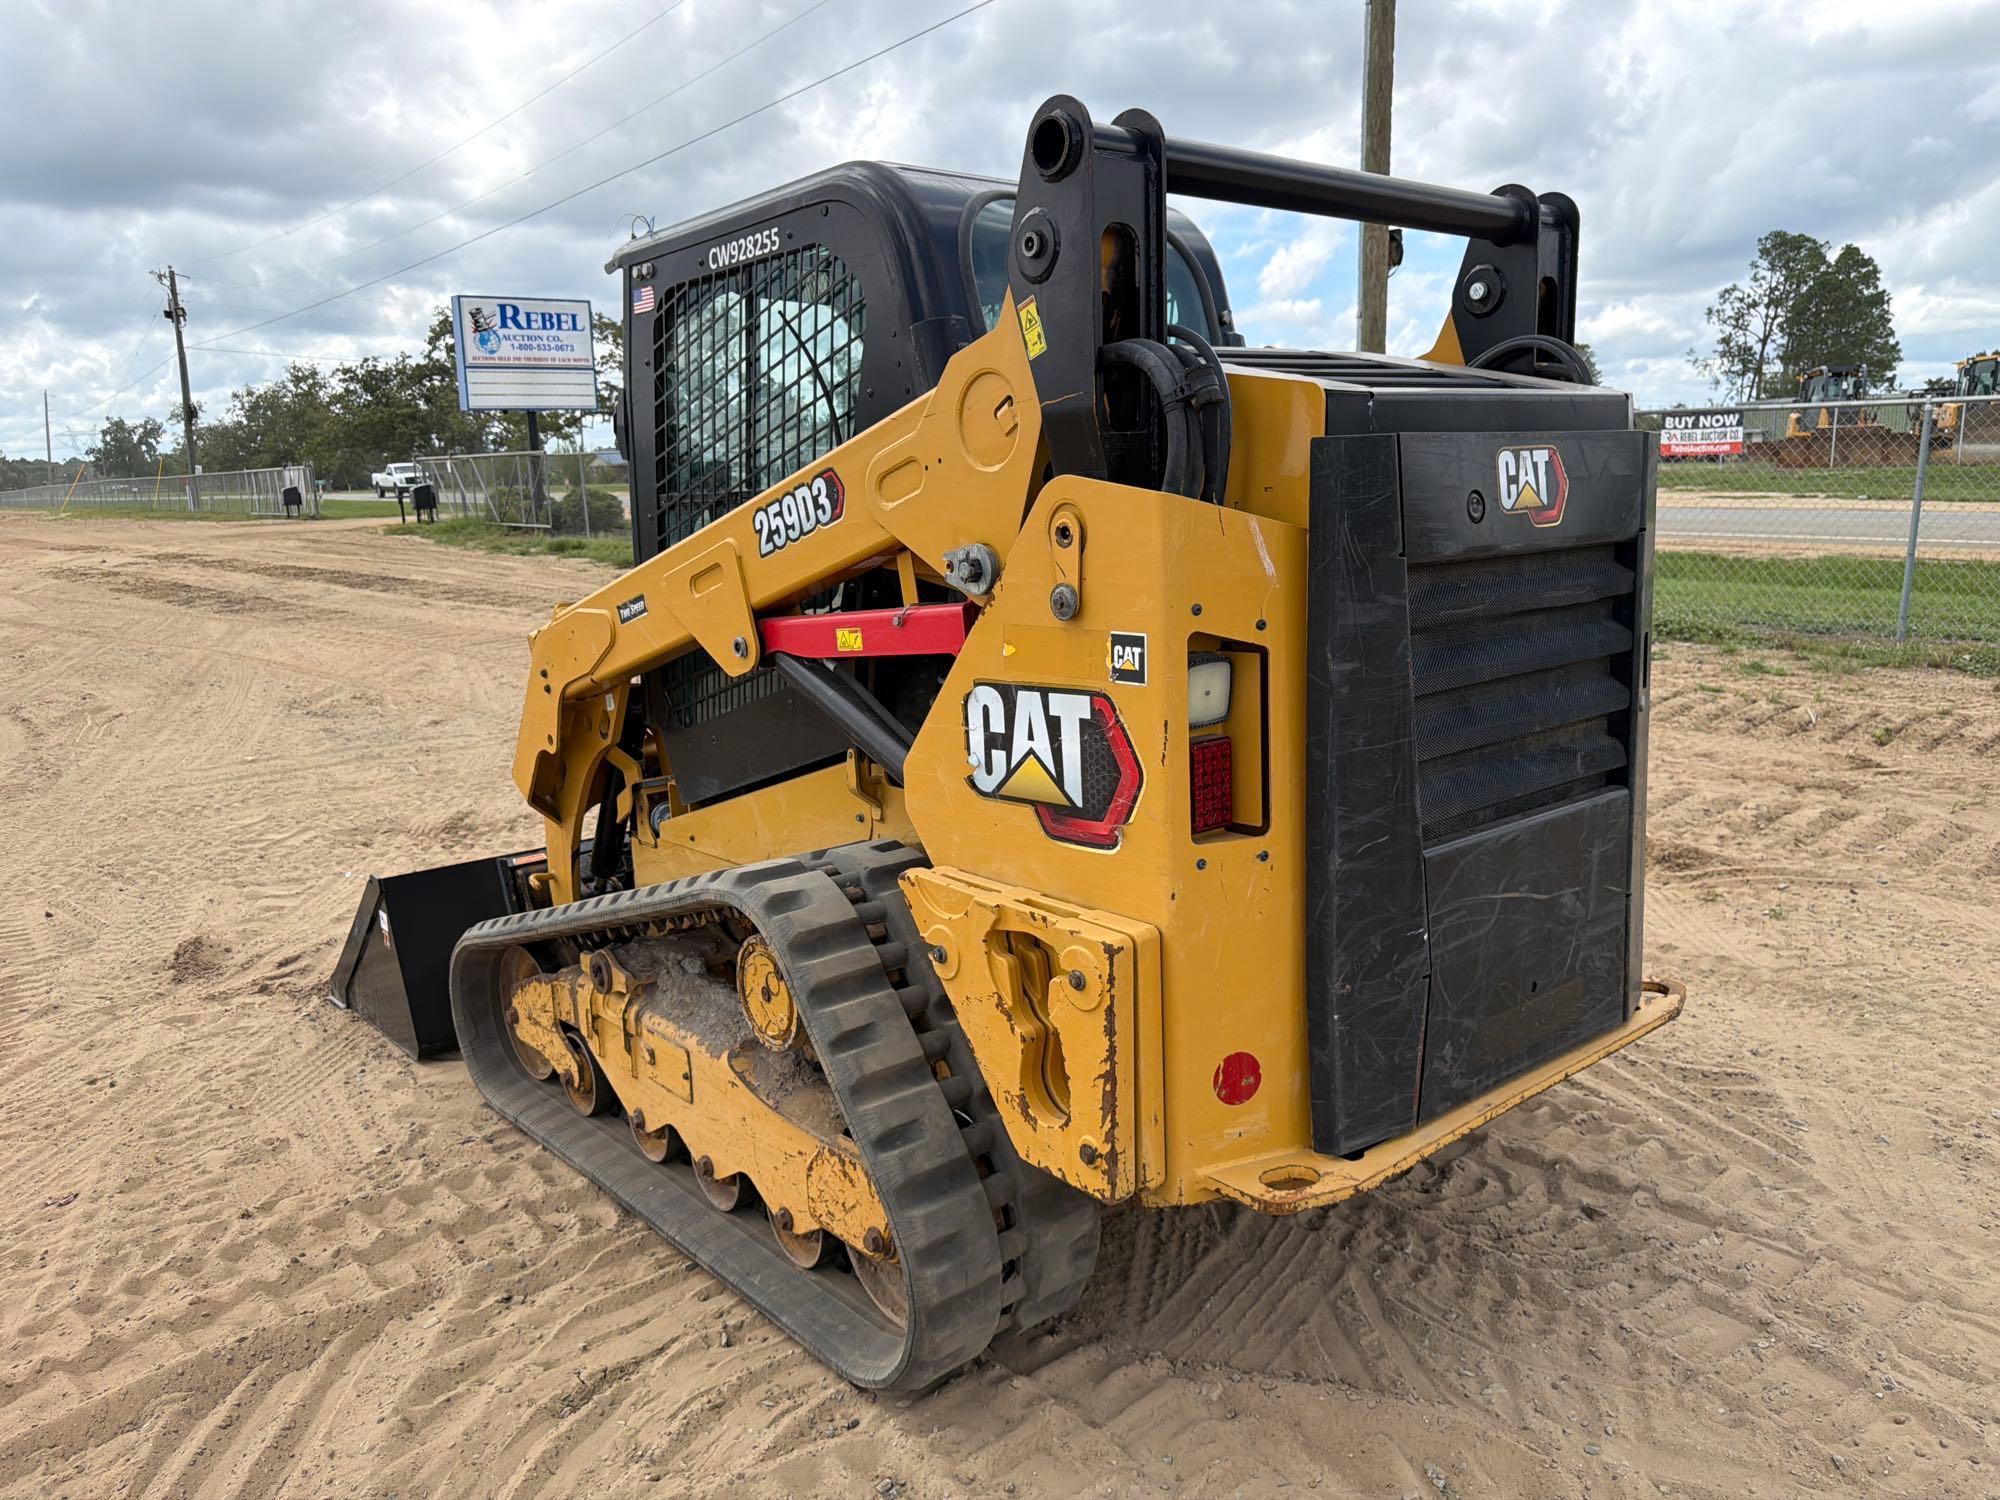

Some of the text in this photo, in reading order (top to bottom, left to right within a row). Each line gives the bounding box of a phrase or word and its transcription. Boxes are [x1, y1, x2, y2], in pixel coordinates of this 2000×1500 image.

[708, 226, 780, 269] CW928255
[497, 304, 586, 332] REBEL
[501, 334, 563, 343] AUCTION CO.
[511, 343, 575, 352] 1-800-533-0673
[1664, 413, 1740, 429] BUY NOW
[1680, 431, 1698, 442] REBEL
[1700, 430, 1728, 441] AUCTION
[1498, 449, 1549, 509] CAT
[754, 477, 832, 556] 259D3
[1113, 645, 1142, 671] CAT
[967, 685, 1091, 808] CAT
